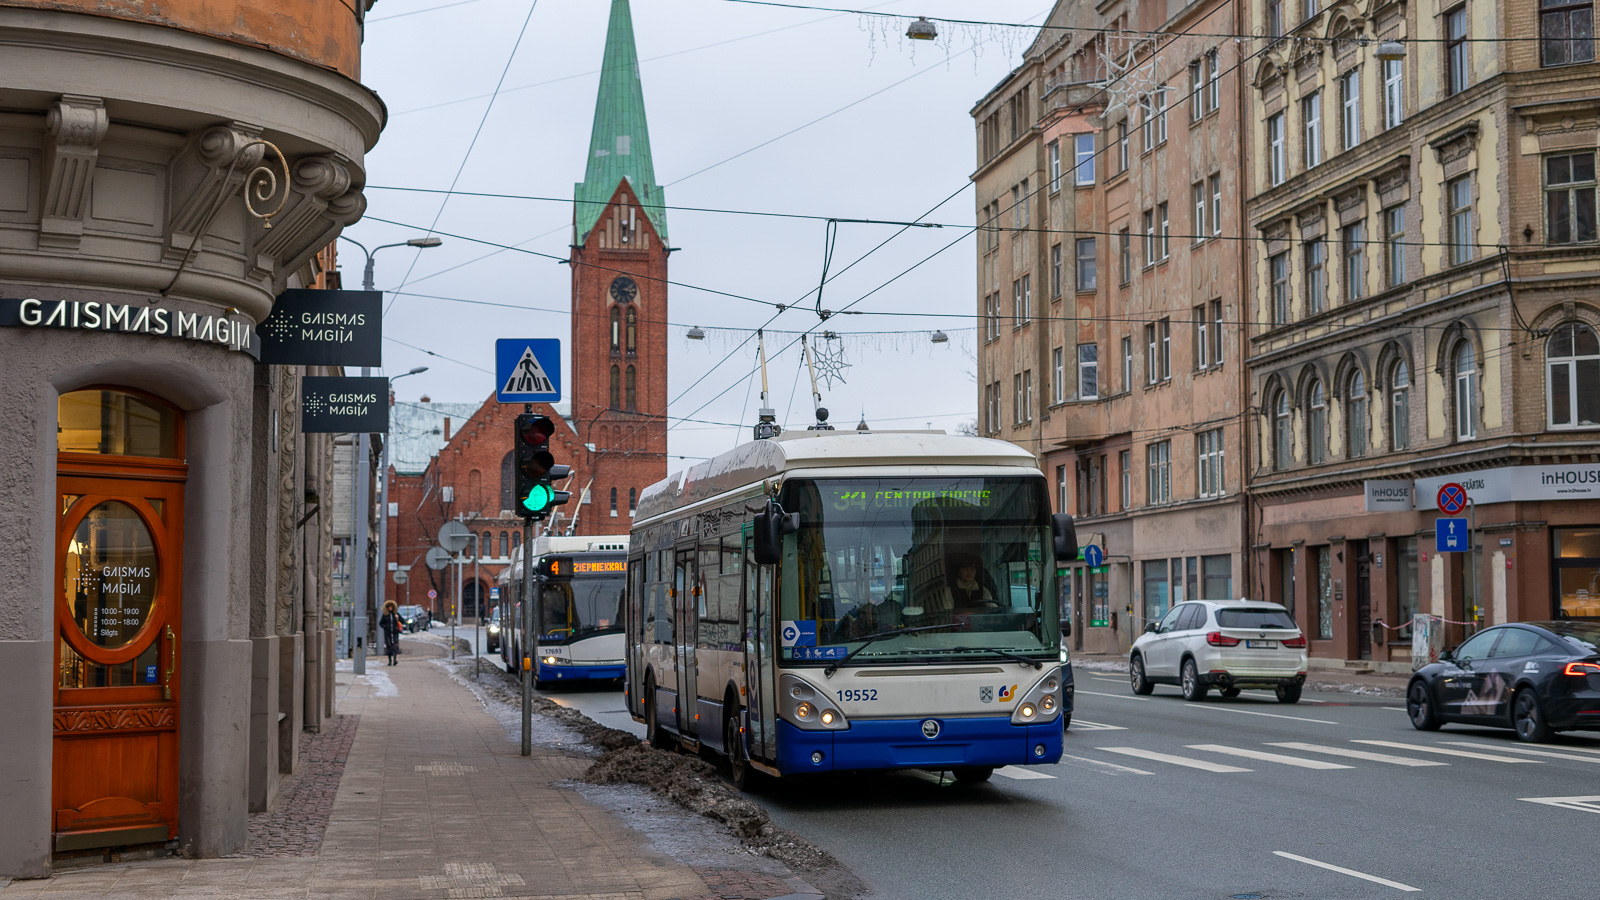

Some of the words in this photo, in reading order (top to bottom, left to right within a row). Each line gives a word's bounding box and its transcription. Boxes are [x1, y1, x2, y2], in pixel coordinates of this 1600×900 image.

[19, 298, 168, 335] GAISMAS
[301, 312, 366, 326] GAISMAS
[329, 393, 377, 403] GAISMAS
[1371, 487, 1409, 497] inHOUSE
[833, 491, 866, 511] 34
[103, 566, 151, 578] GAISMAS
[550, 560, 560, 575] 4
[836, 689, 878, 702] 19552
